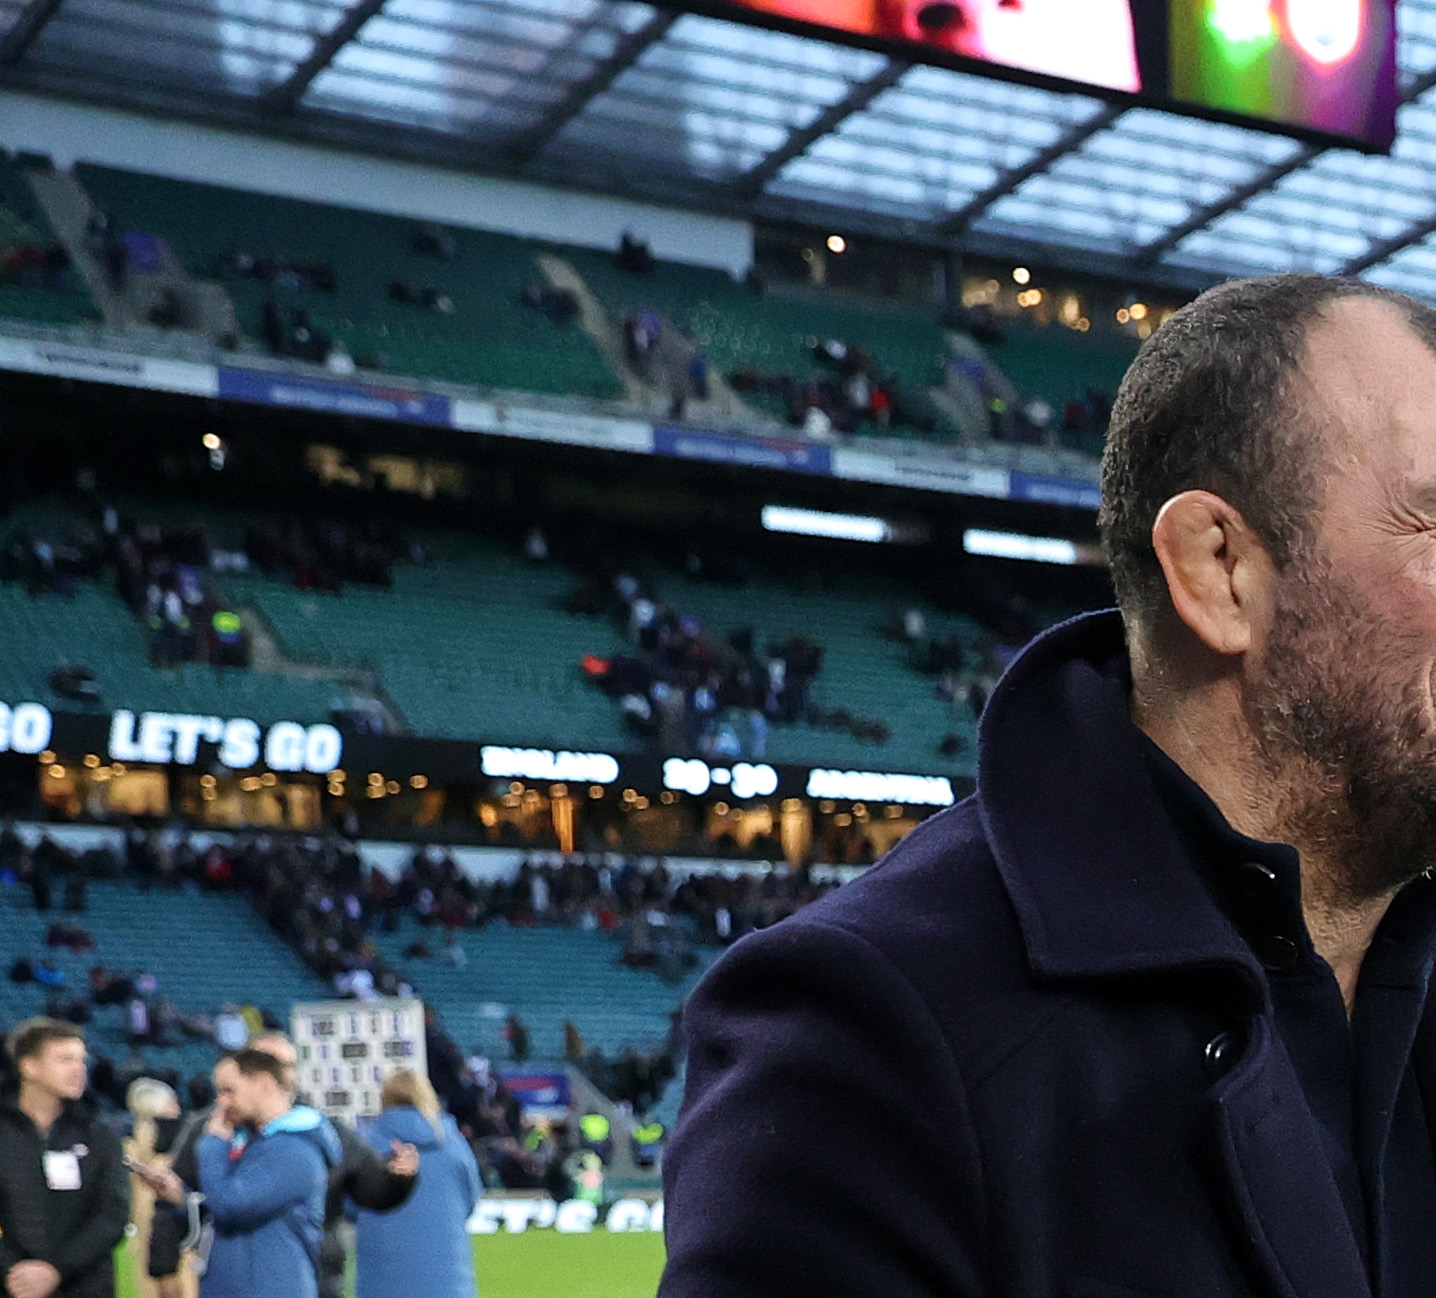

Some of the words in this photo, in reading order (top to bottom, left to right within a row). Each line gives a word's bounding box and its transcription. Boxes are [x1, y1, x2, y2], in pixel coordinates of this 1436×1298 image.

[109, 709, 260, 768] LET'S
[265, 721, 342, 773] GO
[466, 1198, 597, 1234] ET'S
